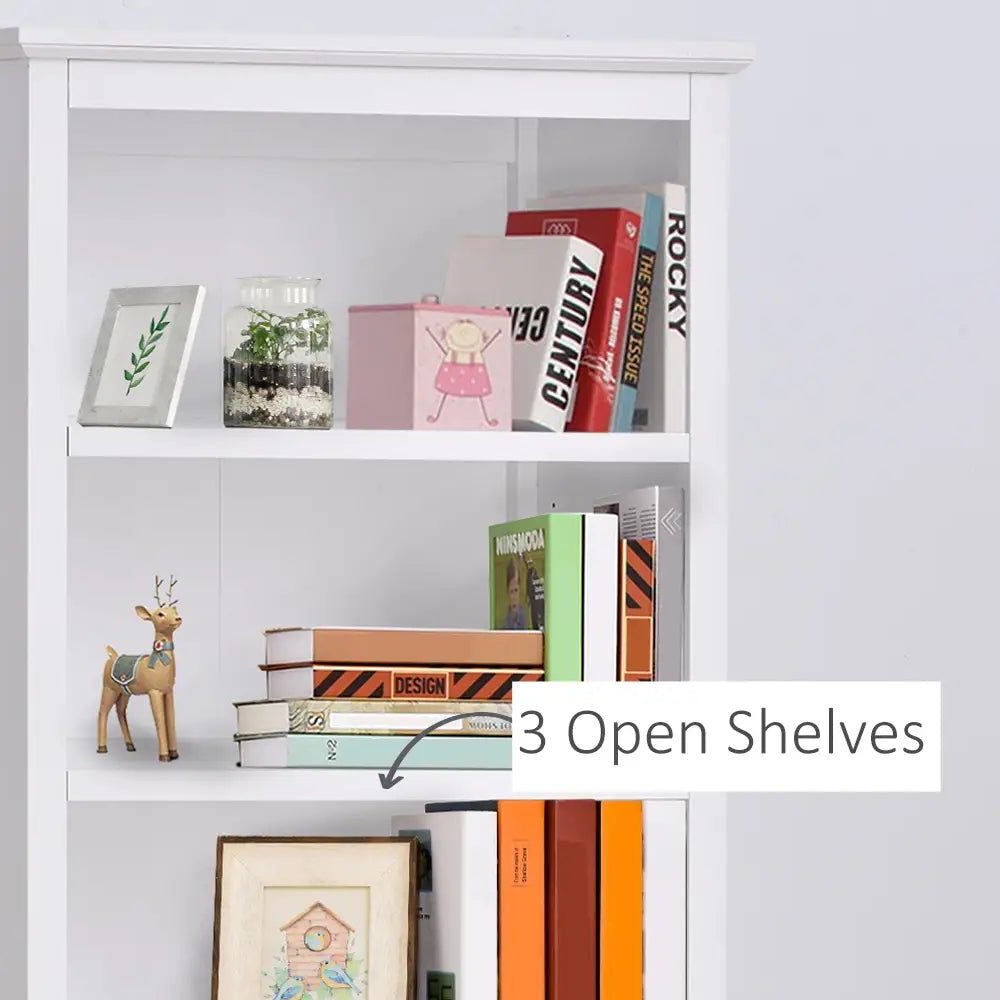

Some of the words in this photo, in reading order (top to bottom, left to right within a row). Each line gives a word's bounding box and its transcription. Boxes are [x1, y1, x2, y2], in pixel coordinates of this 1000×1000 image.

[637, 254, 655, 284] THE
[668, 212, 687, 338] ROCKY
[541, 255, 599, 411] CENTURY
[629, 283, 650, 335] SPEED
[623, 334, 644, 385] ISSUE
[394, 676, 446, 696] DESIGN
